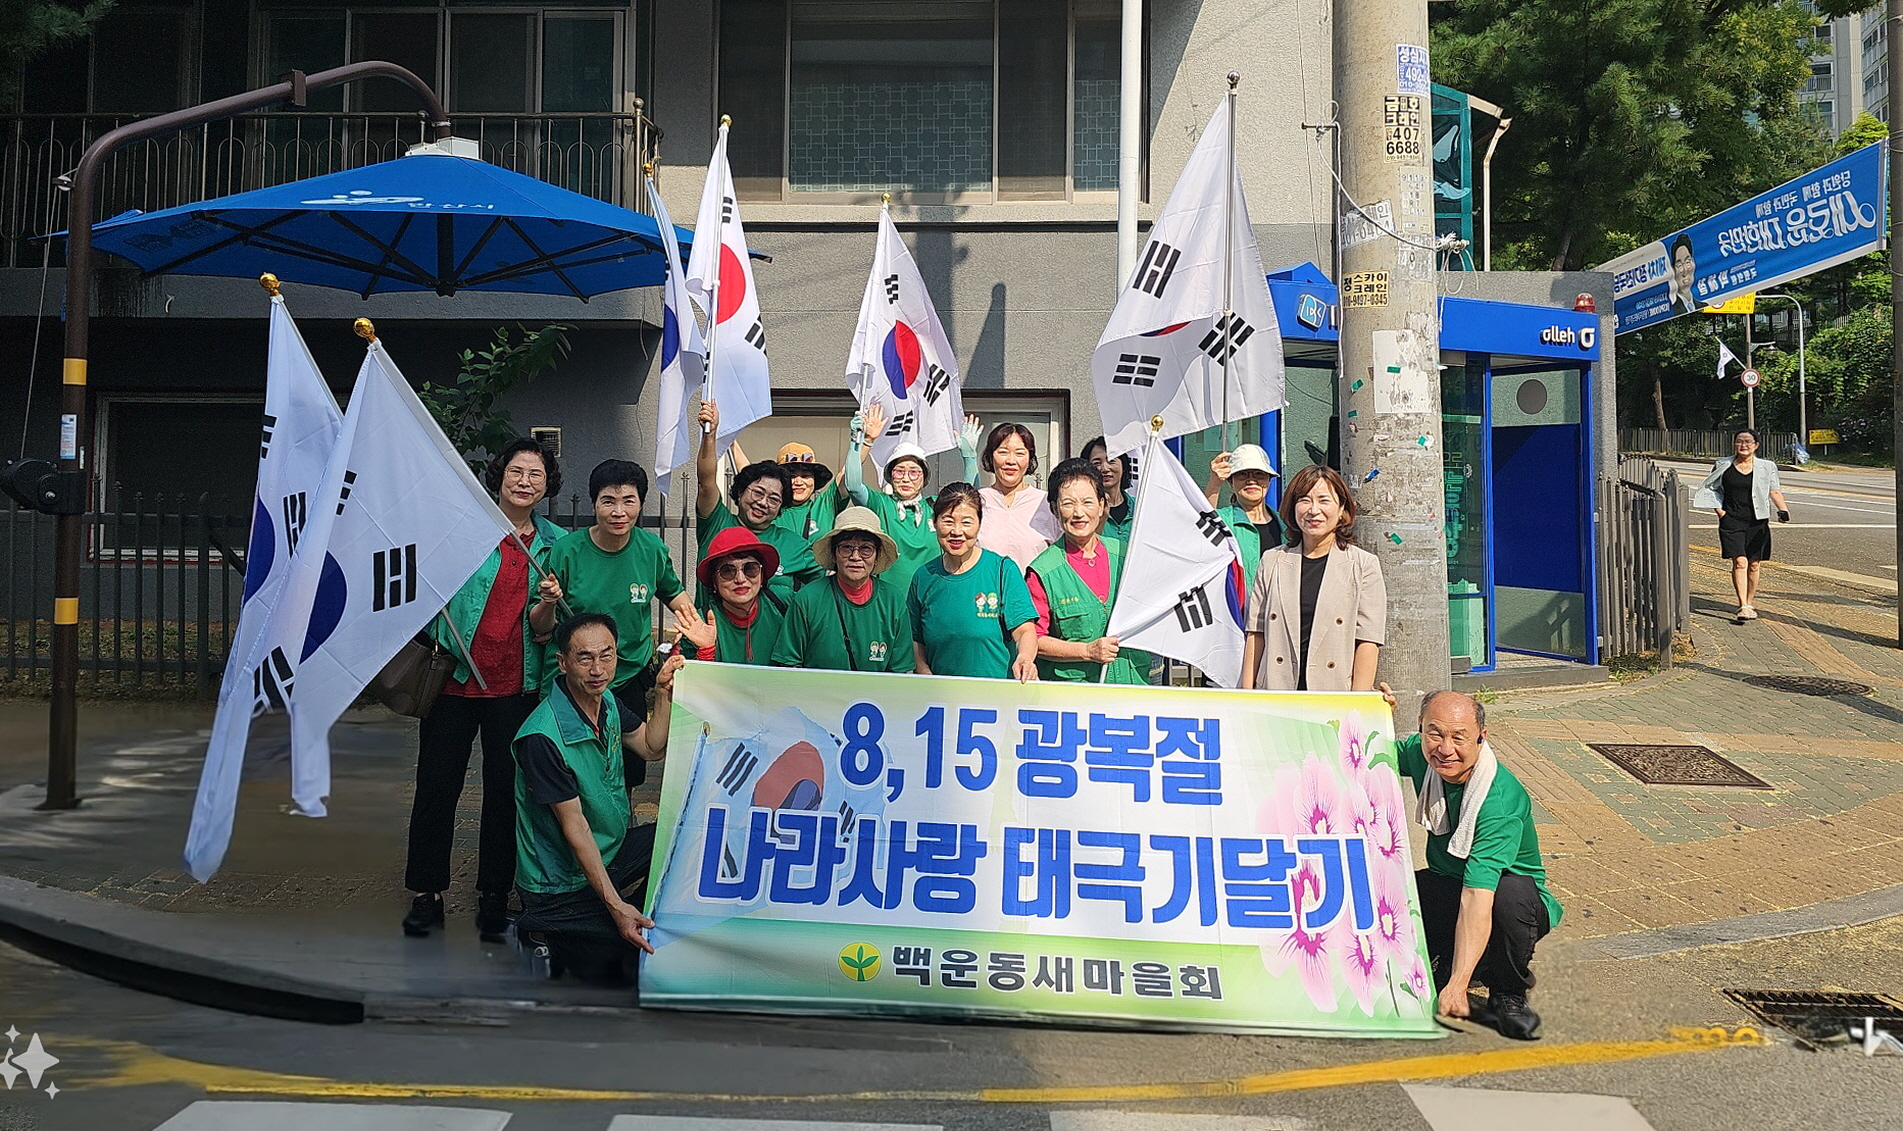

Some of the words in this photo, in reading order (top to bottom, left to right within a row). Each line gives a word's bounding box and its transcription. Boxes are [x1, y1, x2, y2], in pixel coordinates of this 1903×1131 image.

[1386, 141, 1419, 155] 6688
[1353, 273, 1387, 283] 스카이
[1353, 283, 1387, 293] 크레인
[1542, 325, 1575, 343] olleh
[1016, 708, 1223, 806] 광복절
[700, 806, 988, 915] 나라사랑
[1002, 826, 1376, 930] 태극기달기
